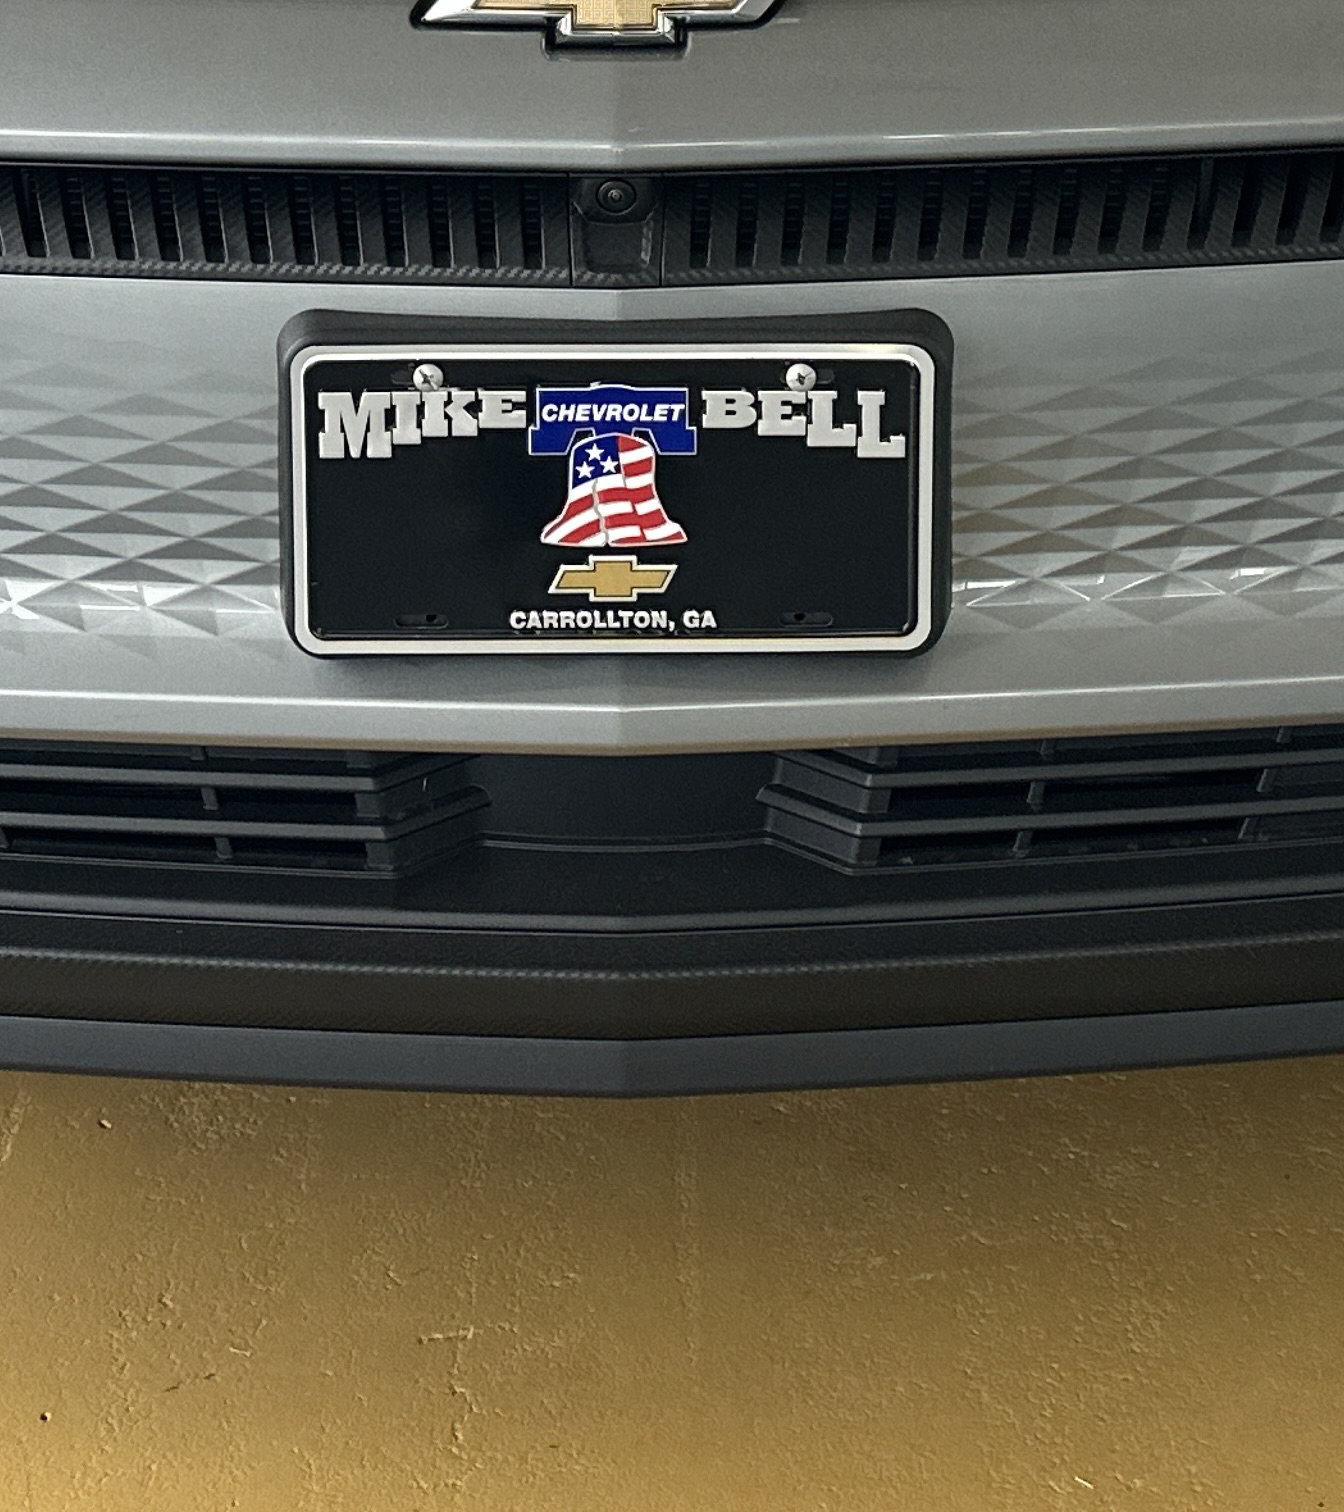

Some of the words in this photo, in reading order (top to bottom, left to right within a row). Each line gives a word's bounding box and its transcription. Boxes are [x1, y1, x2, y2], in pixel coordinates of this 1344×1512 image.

[541, 403, 685, 422] CHEVROLET
[318, 390, 526, 458] MIKE
[701, 390, 906, 458] BELL
[509, 610, 675, 632] CARROLLTON,
[682, 610, 717, 629] GA
